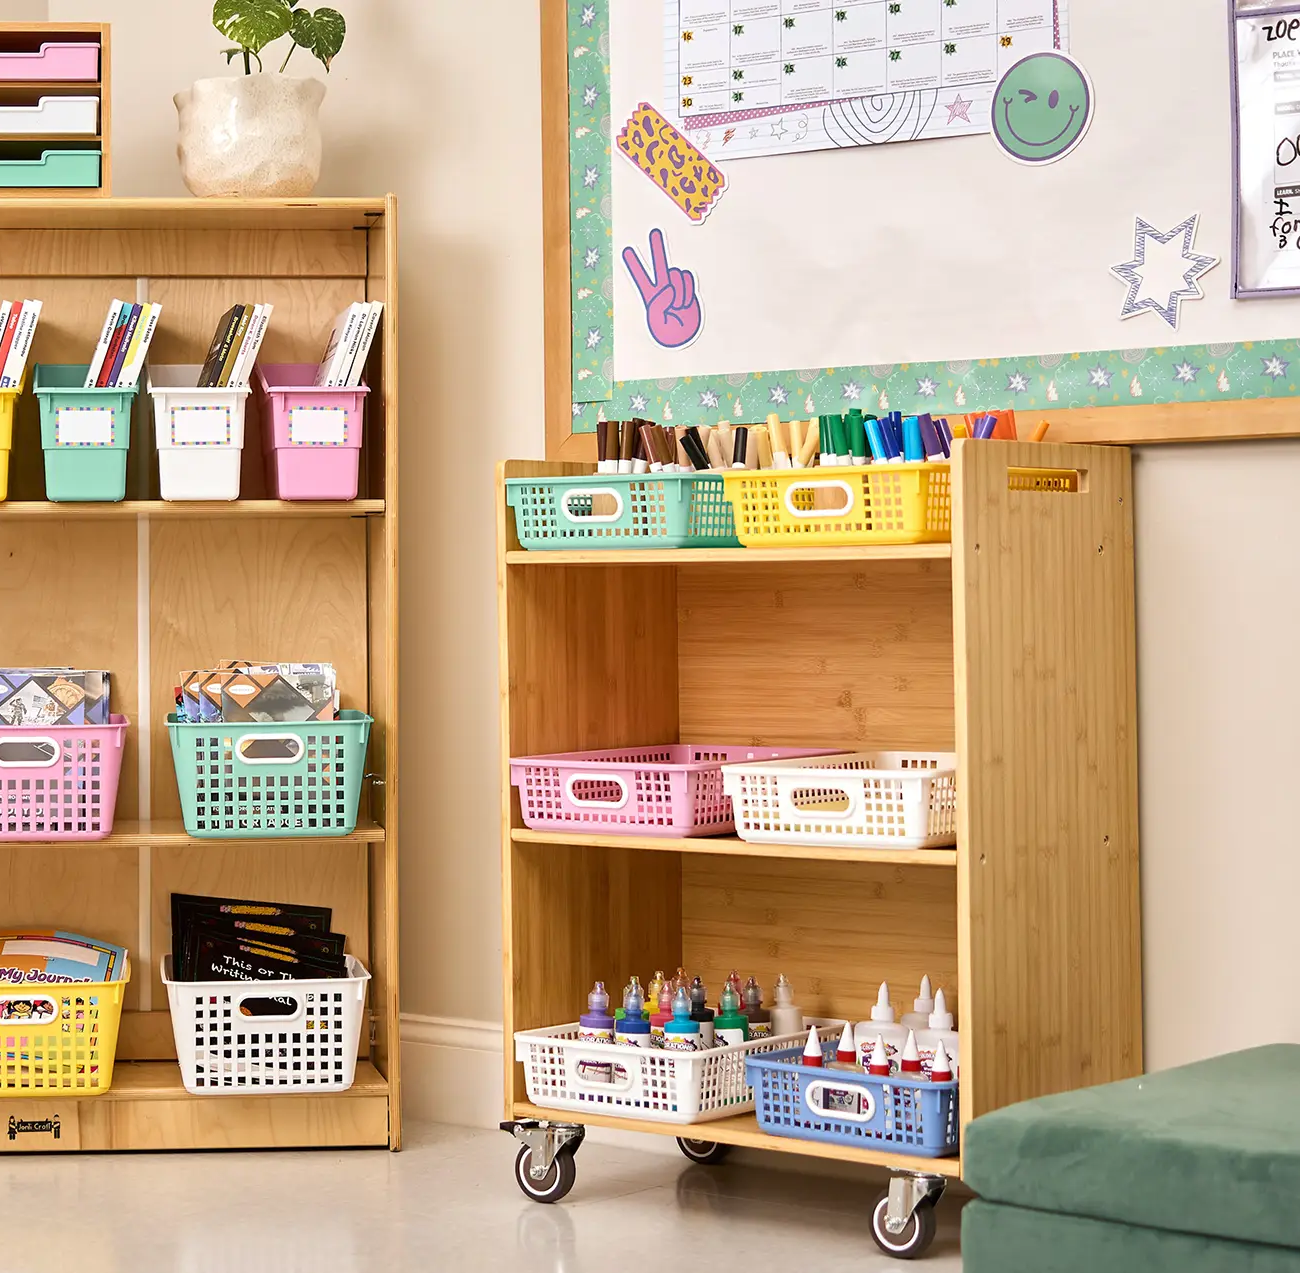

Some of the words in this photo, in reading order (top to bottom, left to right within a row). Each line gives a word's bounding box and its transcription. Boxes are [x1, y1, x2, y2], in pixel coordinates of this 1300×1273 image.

[20, 312, 28, 332] Kristine
[256, 316, 267, 339] Elizabeth
[21, 328, 32, 357] Letourneau
[103, 326, 112, 344] Carroll
[362, 332, 371, 351] Morgan
[224, 955, 252, 970] This
[258, 968, 274, 976] or
[280, 972, 296, 980] Th
